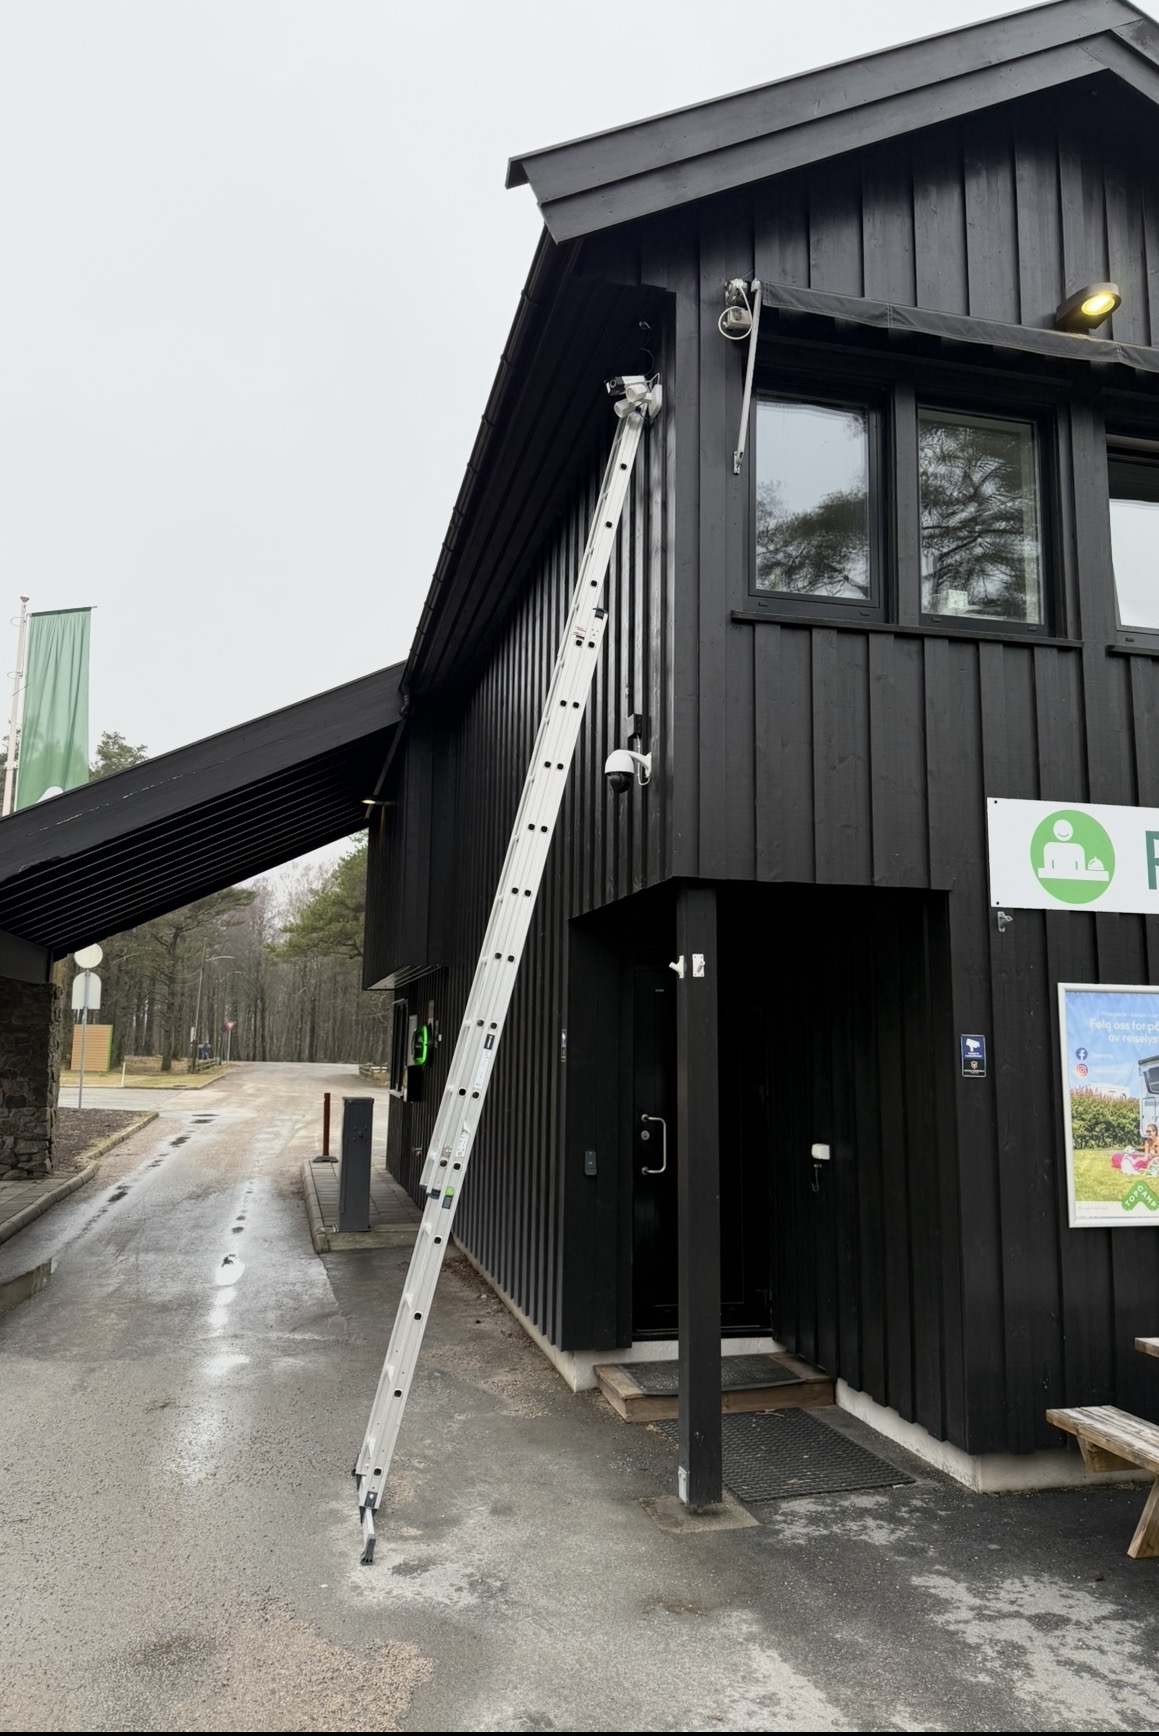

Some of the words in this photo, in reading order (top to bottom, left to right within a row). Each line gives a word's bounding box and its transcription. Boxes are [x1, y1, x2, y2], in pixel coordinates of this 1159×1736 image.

[1114, 1022, 1130, 1031] oss
[1132, 1020, 1145, 1031] for
[1108, 1035, 1121, 1043] av
[1125, 1190, 1138, 1206] TOP
[1137, 1185, 1157, 1206] CAMP
